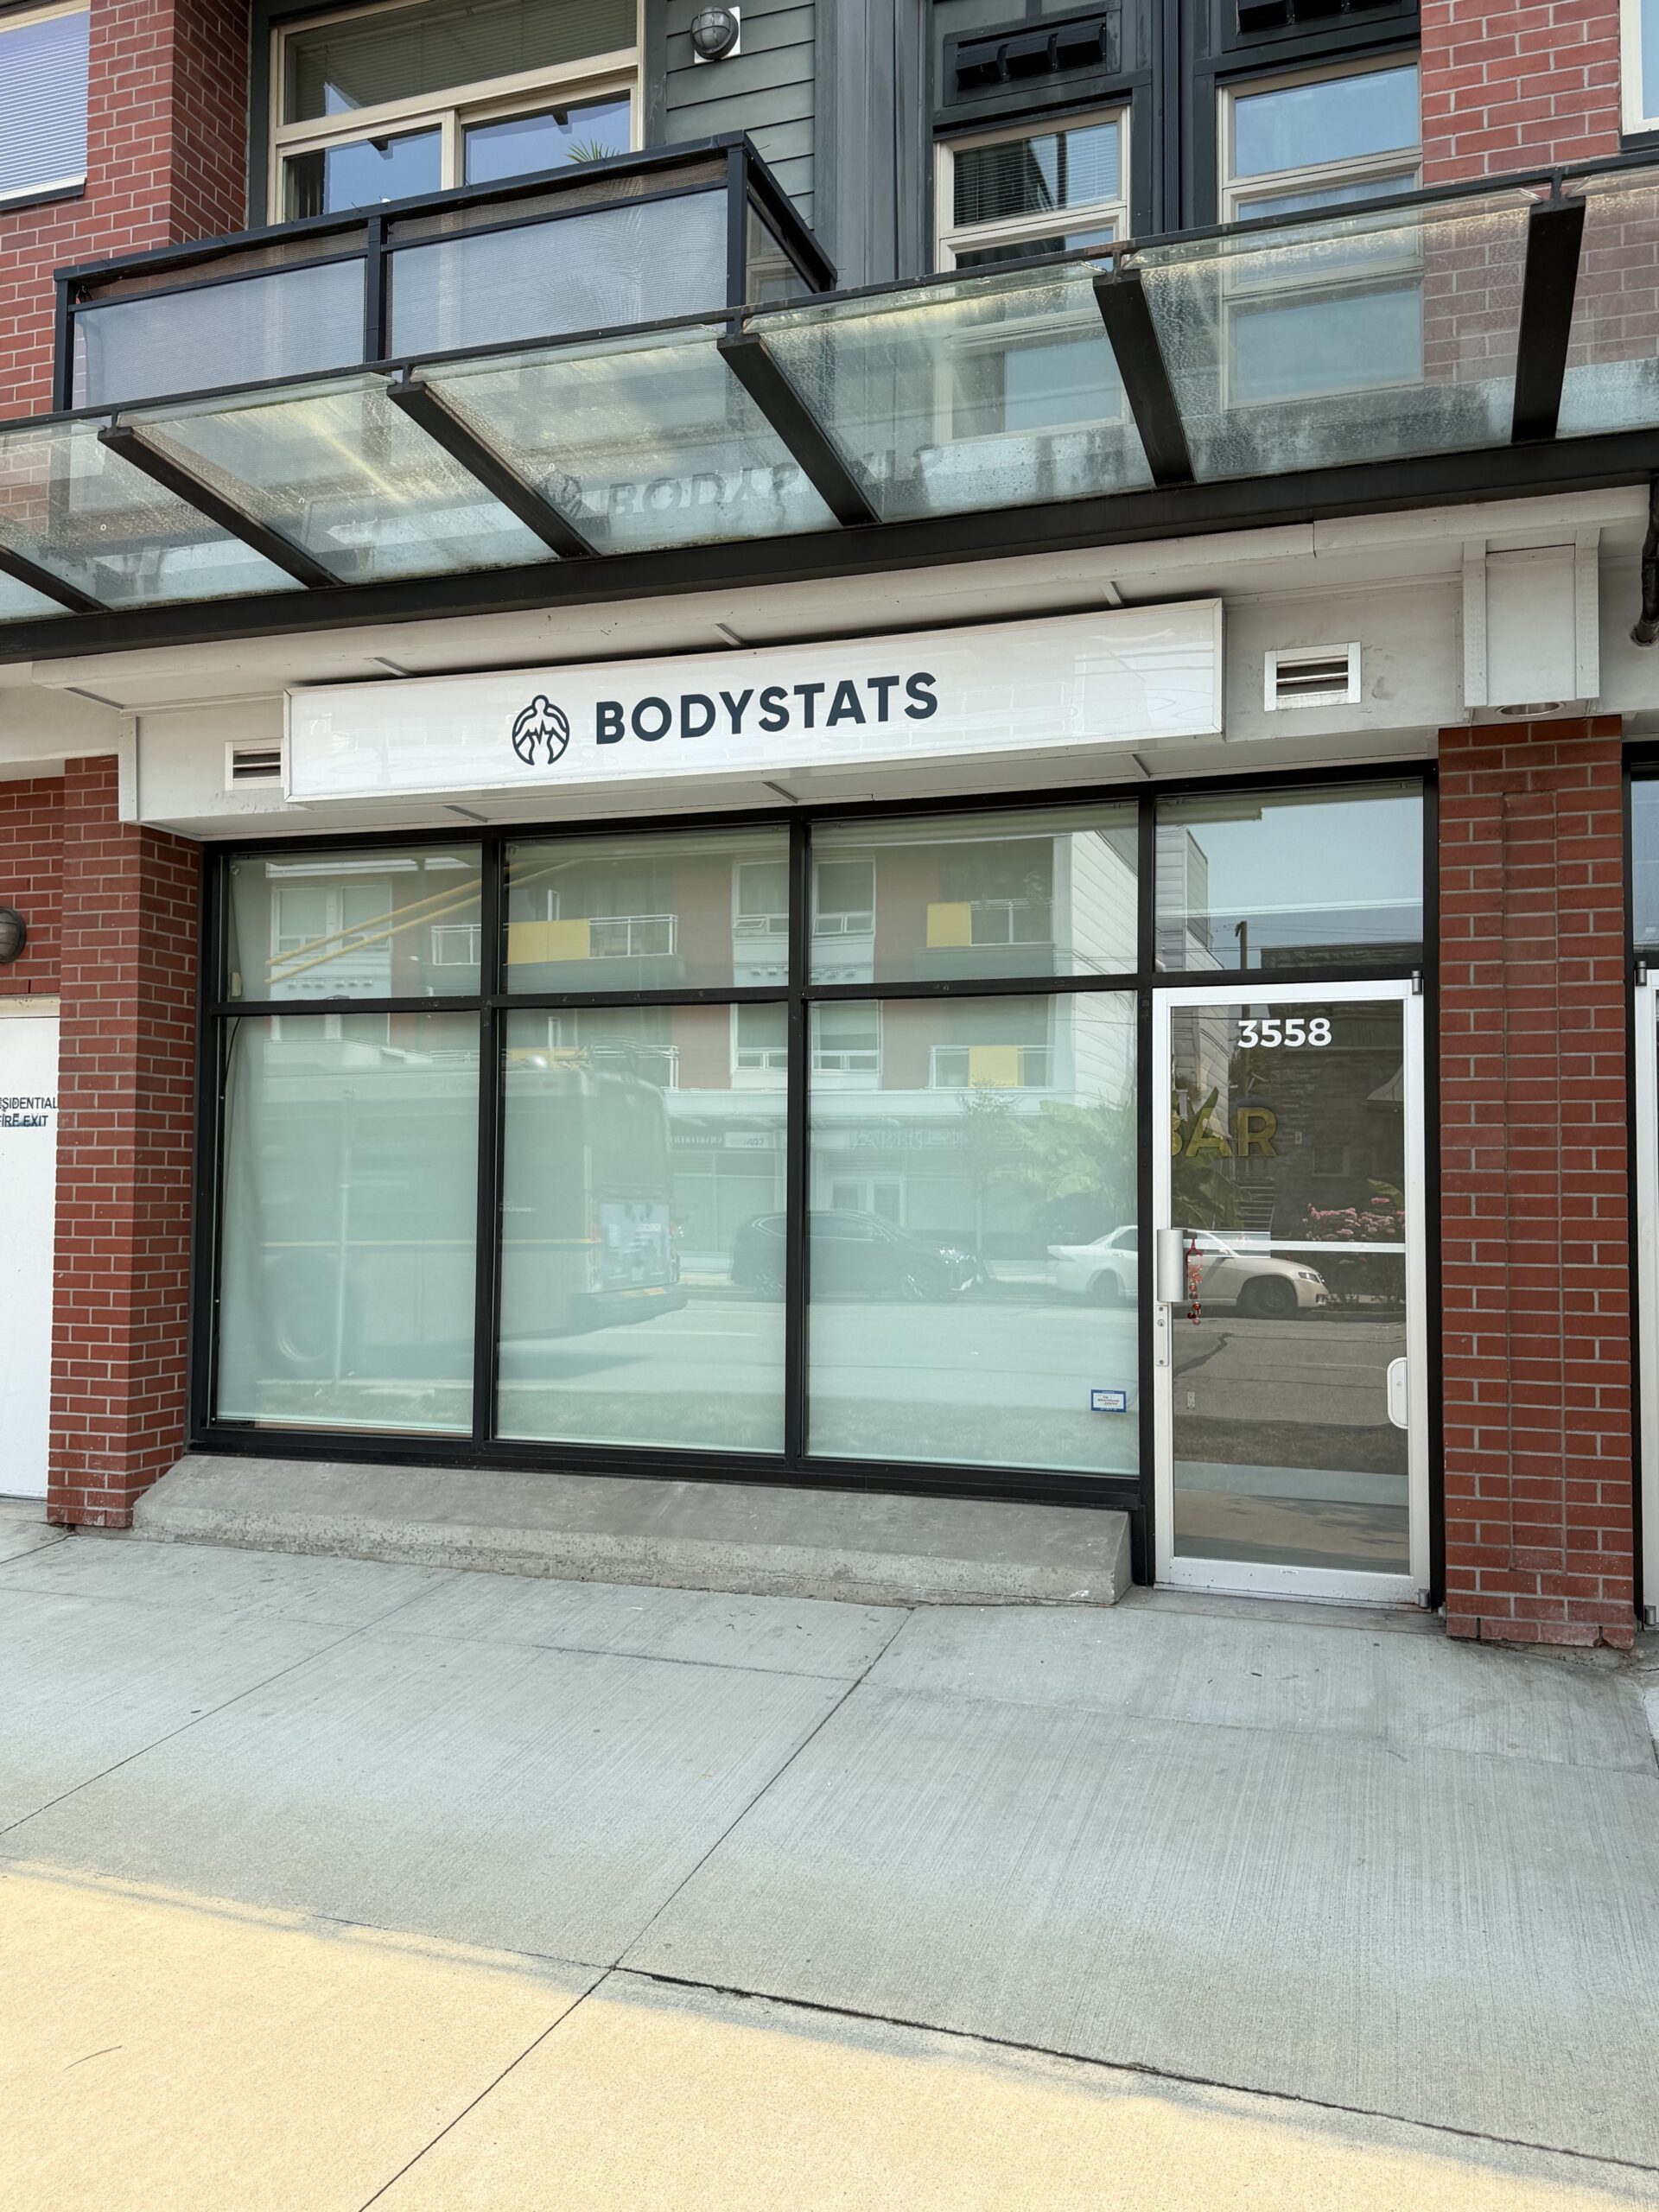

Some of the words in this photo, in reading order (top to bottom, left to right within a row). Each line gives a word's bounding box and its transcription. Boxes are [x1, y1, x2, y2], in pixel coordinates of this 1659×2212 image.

[596, 671, 938, 745] BODYSTATS
[1238, 1018, 1332, 1048] 3558
[0, 1096, 58, 1109] SIDENTIAL
[0, 1114, 19, 1127] IRE
[23, 1115, 48, 1127] EXIT
